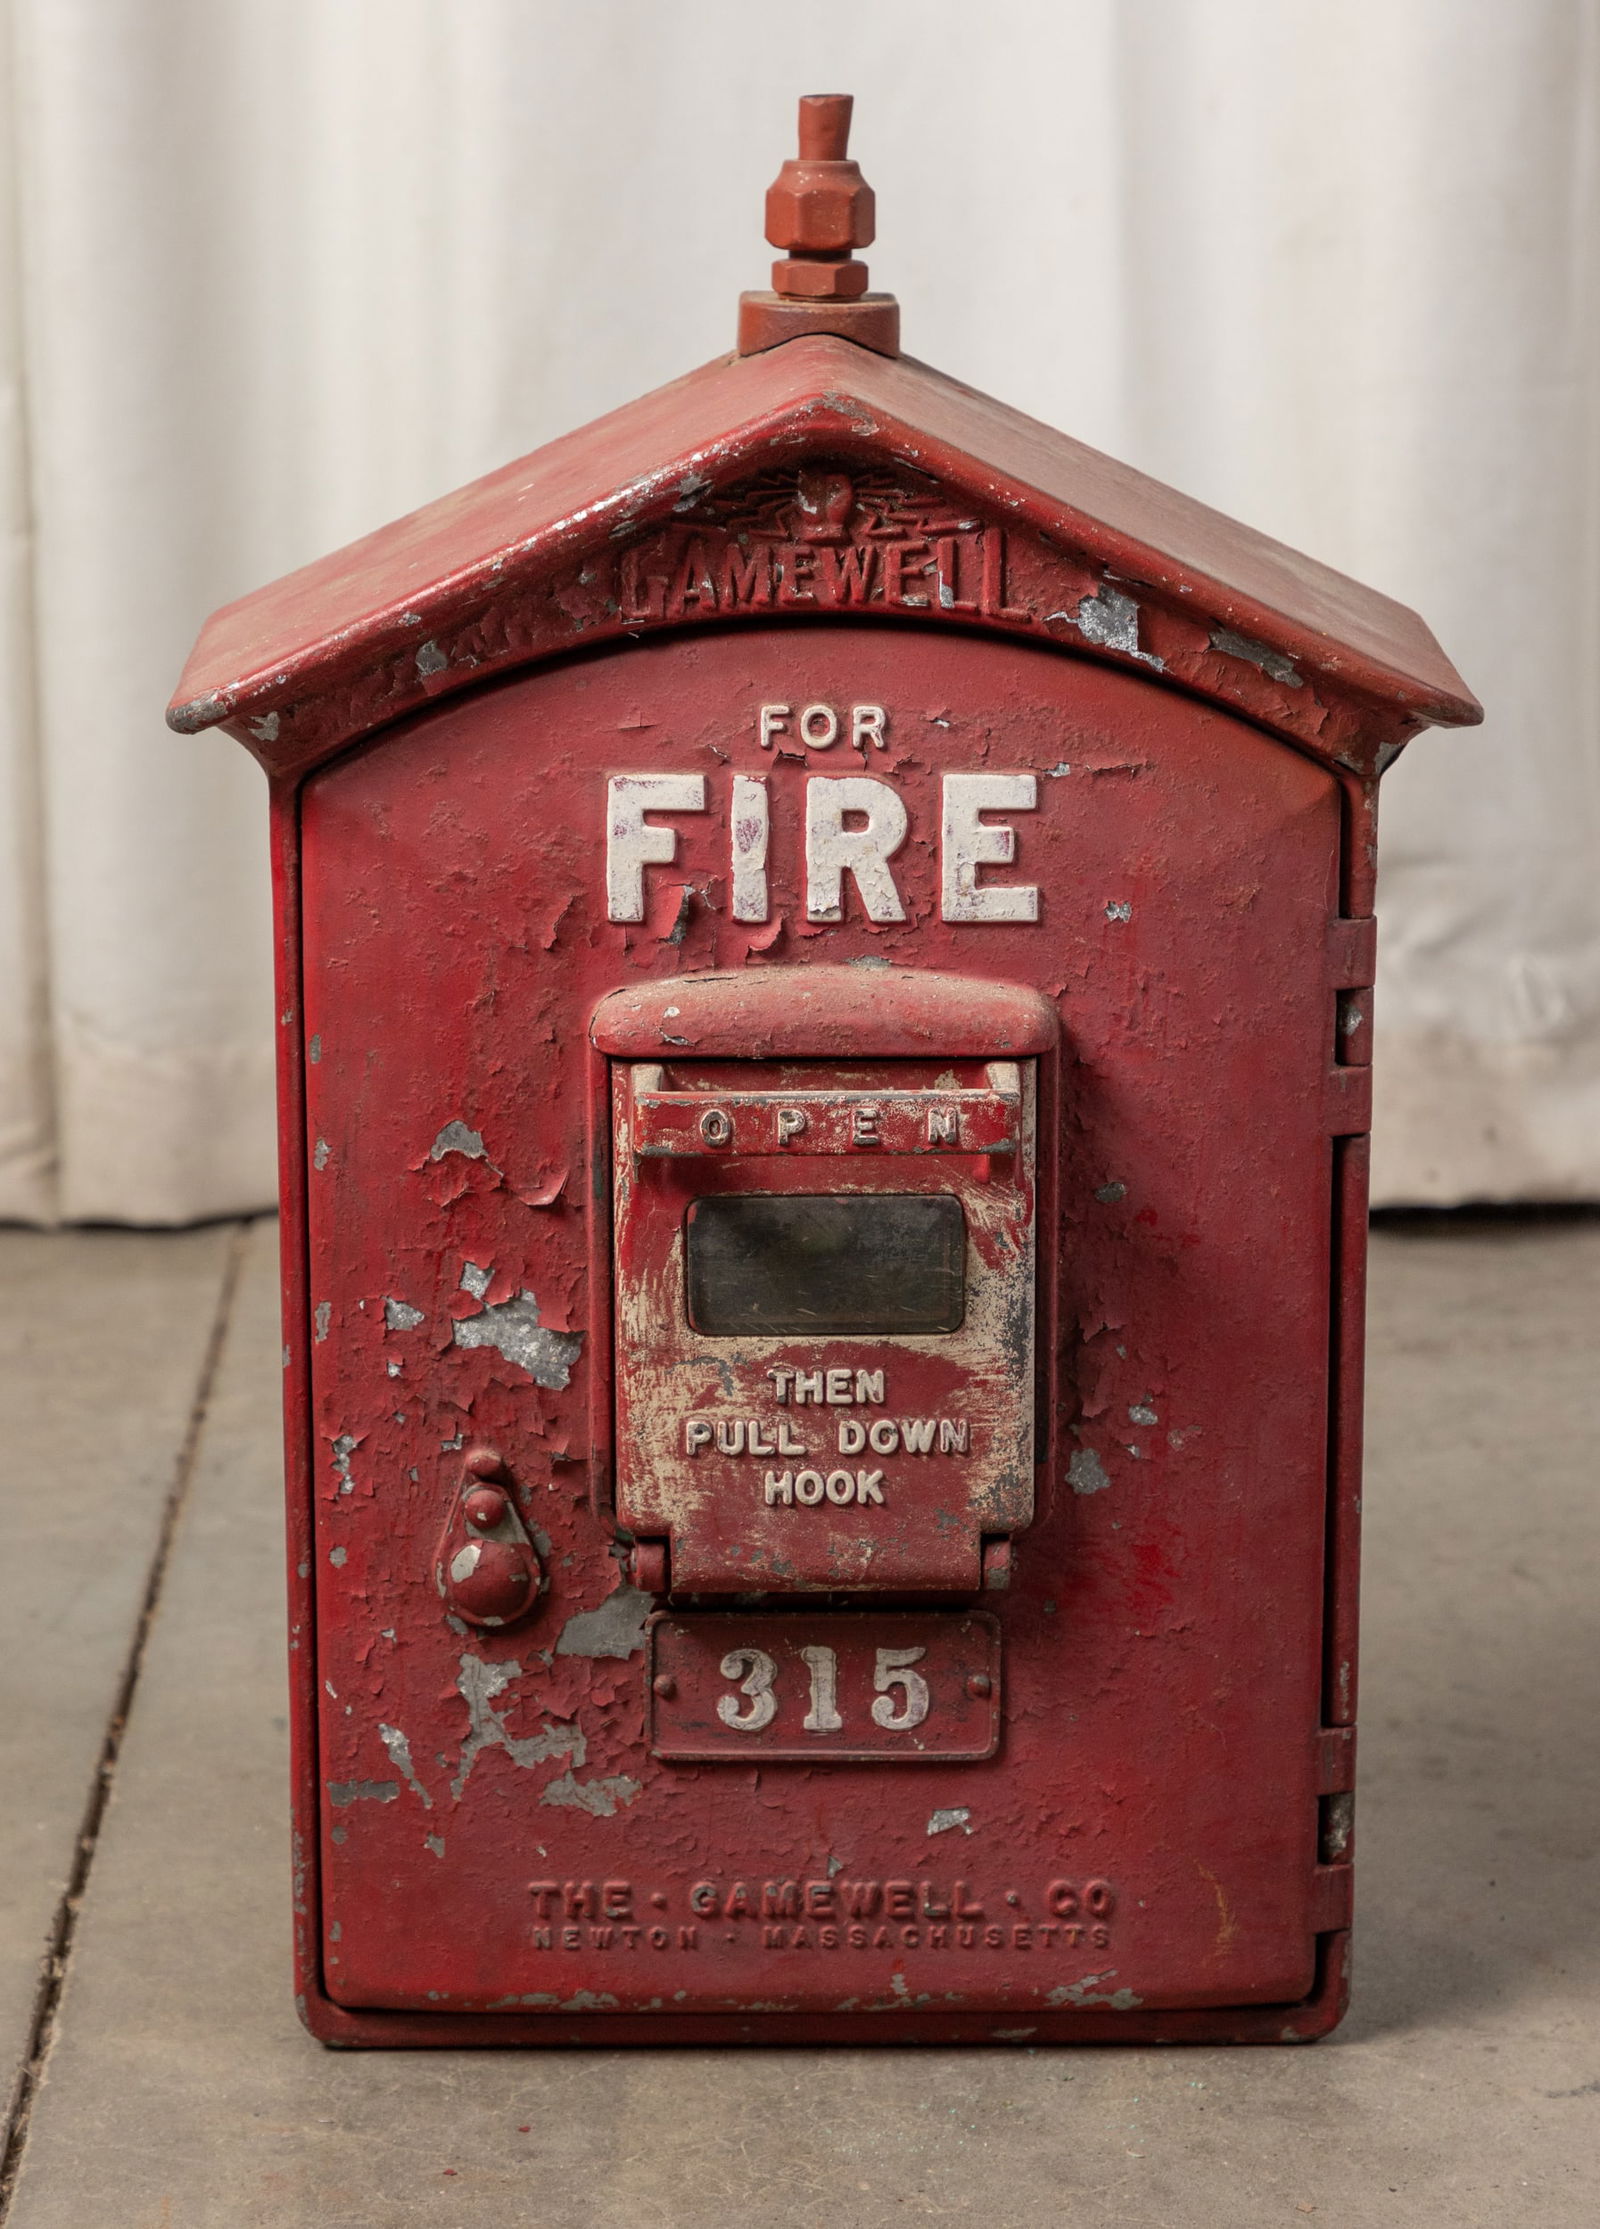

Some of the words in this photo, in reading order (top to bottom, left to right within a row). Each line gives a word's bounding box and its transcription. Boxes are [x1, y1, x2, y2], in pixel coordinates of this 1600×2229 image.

[760, 705, 886, 749] FOR
[607, 773, 1038, 922] FIRE
[700, 1108, 958, 1147] OPEN
[767, 1369, 885, 1404] THEN
[686, 1421, 805, 1455] PULL
[839, 1419, 968, 1455] DOWN
[765, 1470, 884, 1506] HOOK
[717, 1646, 930, 1732] 315
[528, 1880, 632, 1918] THE
[690, 1880, 984, 1917] GAMEWELL
[532, 1926, 698, 1951] NEWTON
[763, 1925, 1109, 1950] MASSACHUSETTS
